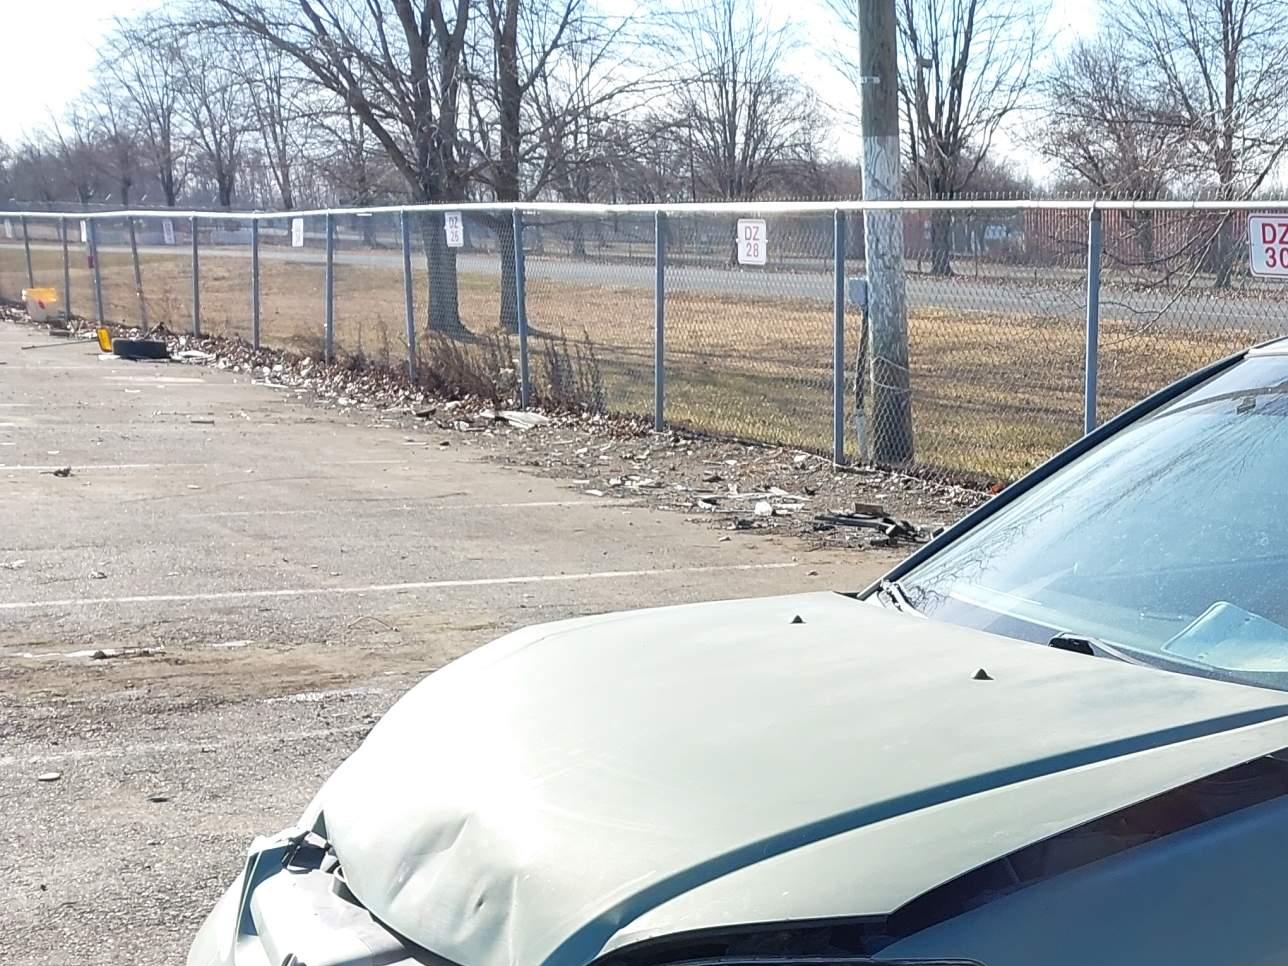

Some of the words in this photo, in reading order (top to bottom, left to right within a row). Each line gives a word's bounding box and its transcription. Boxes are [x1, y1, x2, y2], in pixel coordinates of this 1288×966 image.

[448, 215, 459, 229] DZ
[744, 225, 760, 241] DZ
[745, 242, 760, 258] 28
